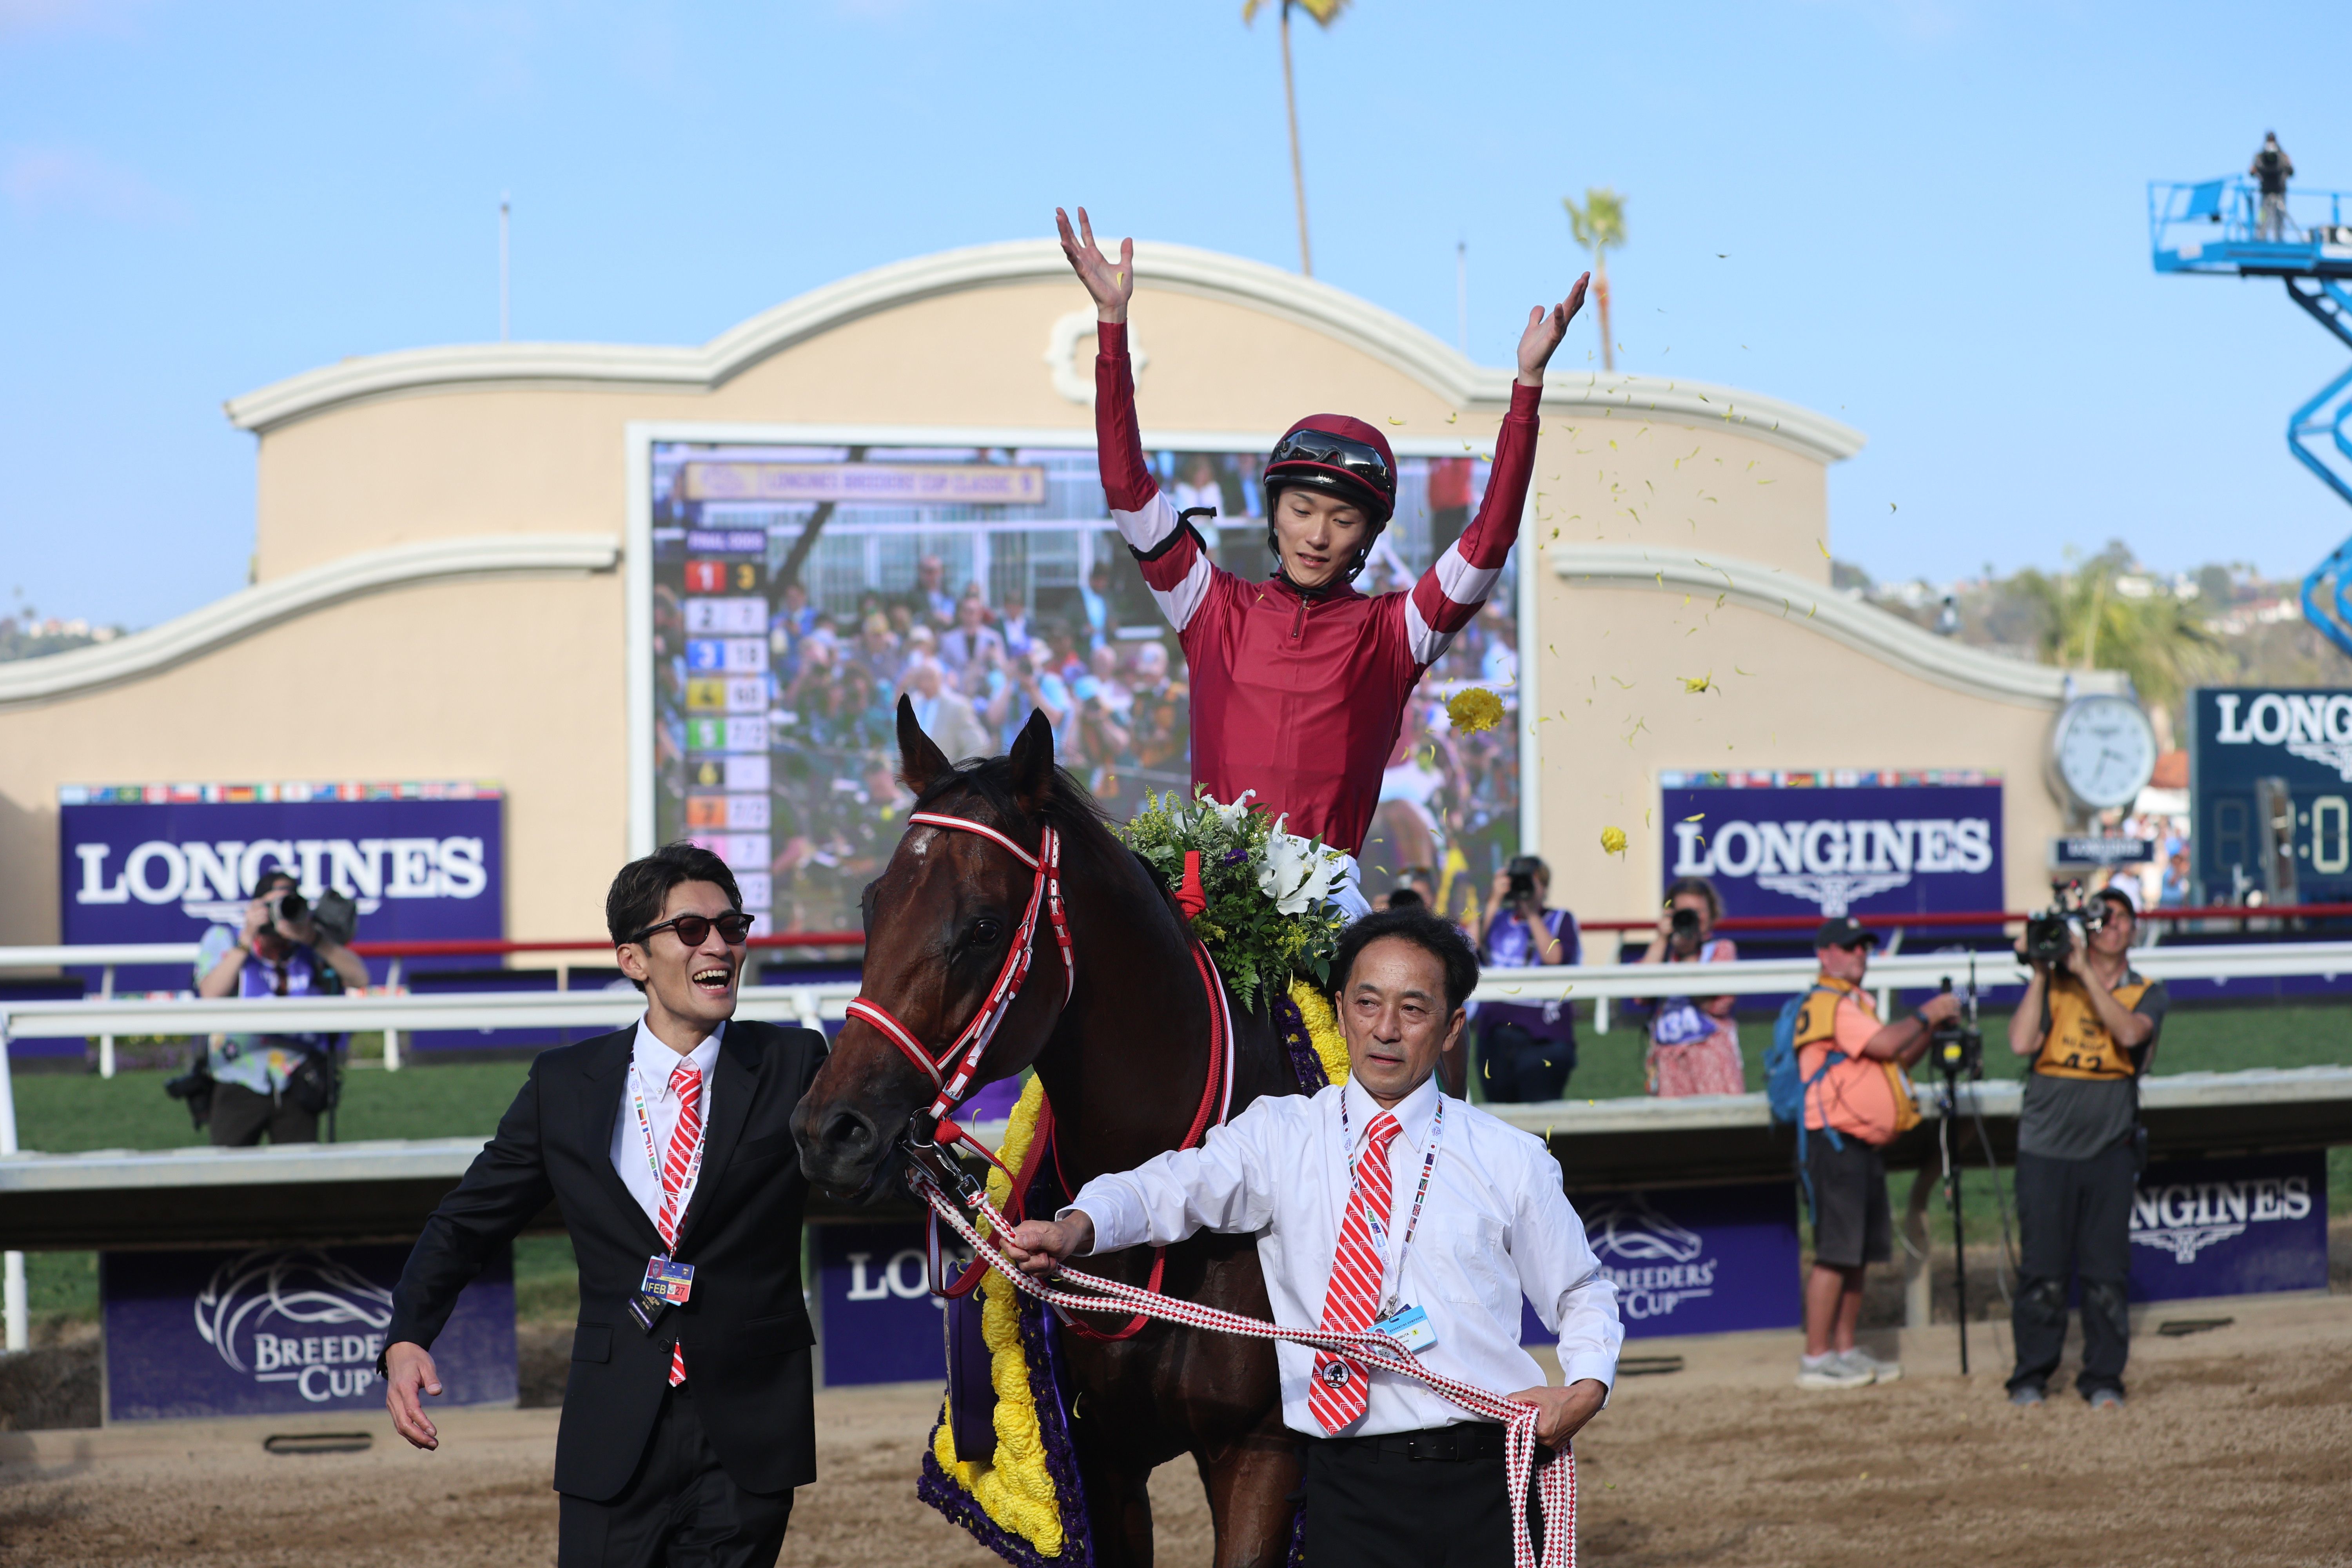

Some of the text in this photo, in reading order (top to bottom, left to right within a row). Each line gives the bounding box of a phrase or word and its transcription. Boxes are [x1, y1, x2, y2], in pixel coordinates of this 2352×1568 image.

[698, 563, 756, 591] 1 3
[698, 641, 717, 669] 3
[2215, 692, 2352, 746] LONG
[1672, 817, 1993, 877] LONGINES
[76, 837, 487, 904] LONGINES
[2129, 1176, 2312, 1230] NGINES
[675, 1287, 685, 1296] 27
[1625, 1289, 1680, 1319] CUP
[1389, 1315, 1423, 1333] QUARANTINE COMPOUND
[254, 1333, 386, 1372] BREEDE
[298, 1364, 374, 1403] CUP
